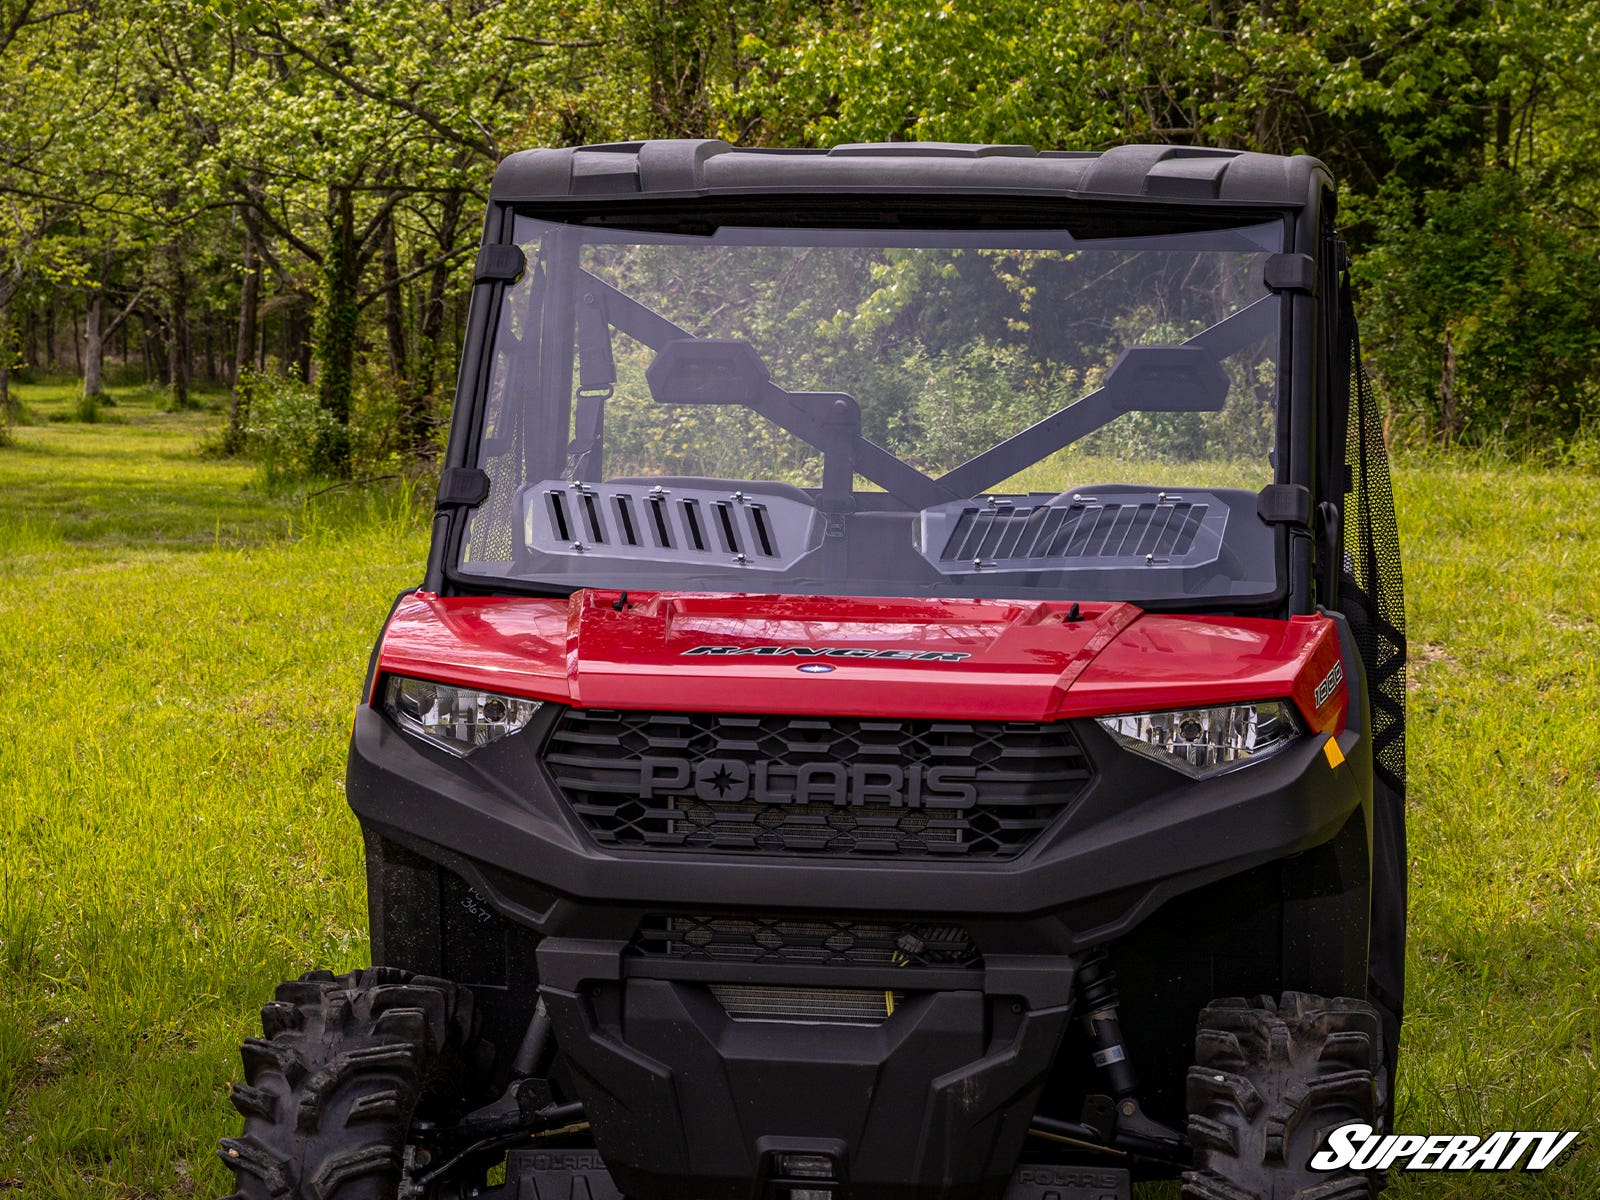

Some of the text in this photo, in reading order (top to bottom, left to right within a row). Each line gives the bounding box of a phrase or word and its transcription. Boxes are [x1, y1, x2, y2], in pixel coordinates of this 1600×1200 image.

[680, 646, 972, 662] RANGER
[1314, 659, 1343, 710] 1000
[640, 756, 977, 809] POLARIS
[461, 897, 491, 922] 3677
